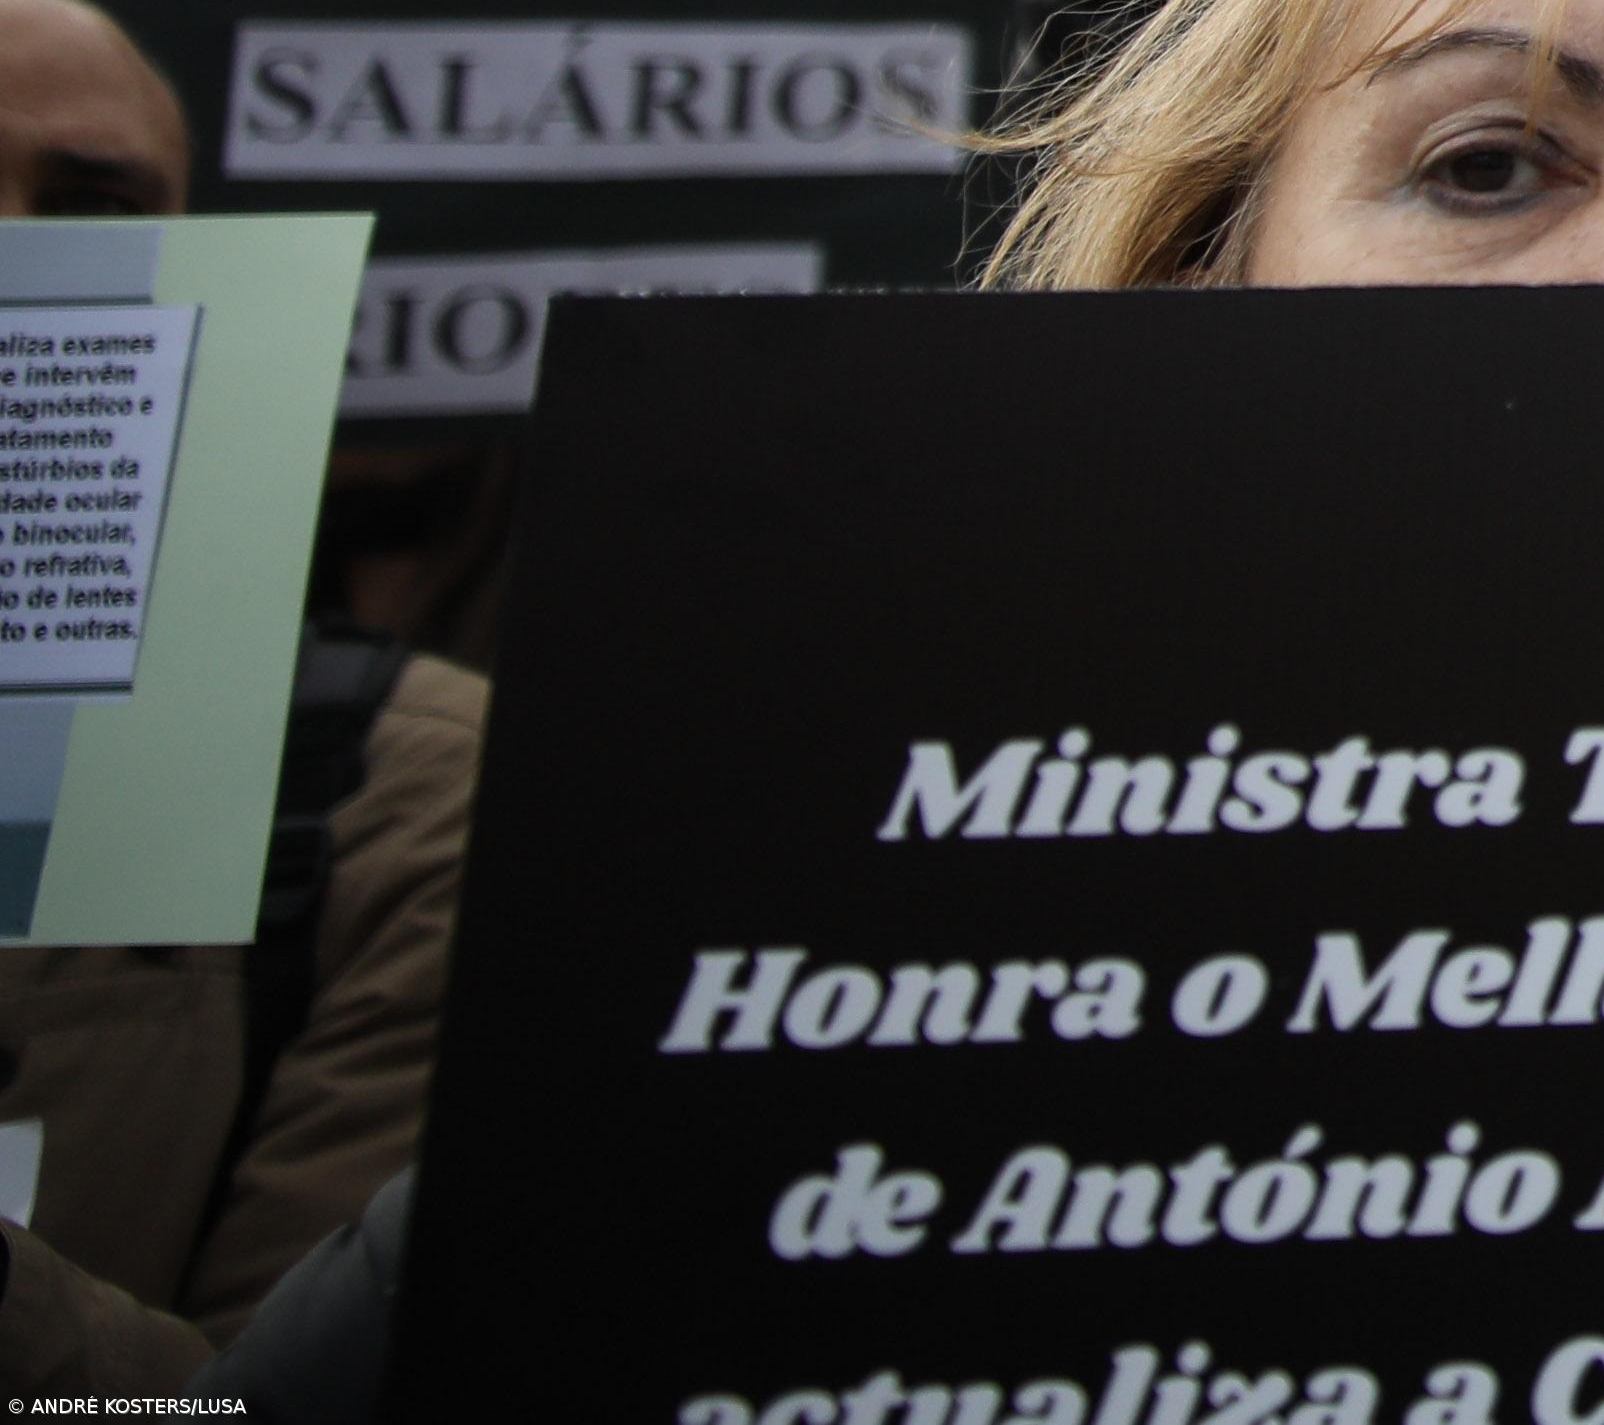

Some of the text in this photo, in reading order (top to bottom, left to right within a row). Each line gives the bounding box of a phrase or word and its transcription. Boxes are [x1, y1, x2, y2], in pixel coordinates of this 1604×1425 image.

[246, 27, 960, 147] SALÁRIOS
[61, 335, 156, 356] exames
[24, 360, 137, 386] intervém
[139, 397, 154, 416] e
[110, 455, 139, 479] da
[64, 487, 142, 511] ocular
[13, 520, 136, 546] binocular,
[24, 551, 131, 578] refrativa,
[26, 586, 58, 609] de
[65, 582, 138, 608] lentes
[33, 622, 48, 641] e
[55, 615, 138, 641] outras.
[877, 726, 1524, 842] Ministra
[659, 949, 1142, 1053] Honra
[1171, 950, 1268, 1038] o
[769, 1143, 942, 1259] de
[951, 1124, 1558, 1254] António
[1405, 1362, 1498, 1425] a
